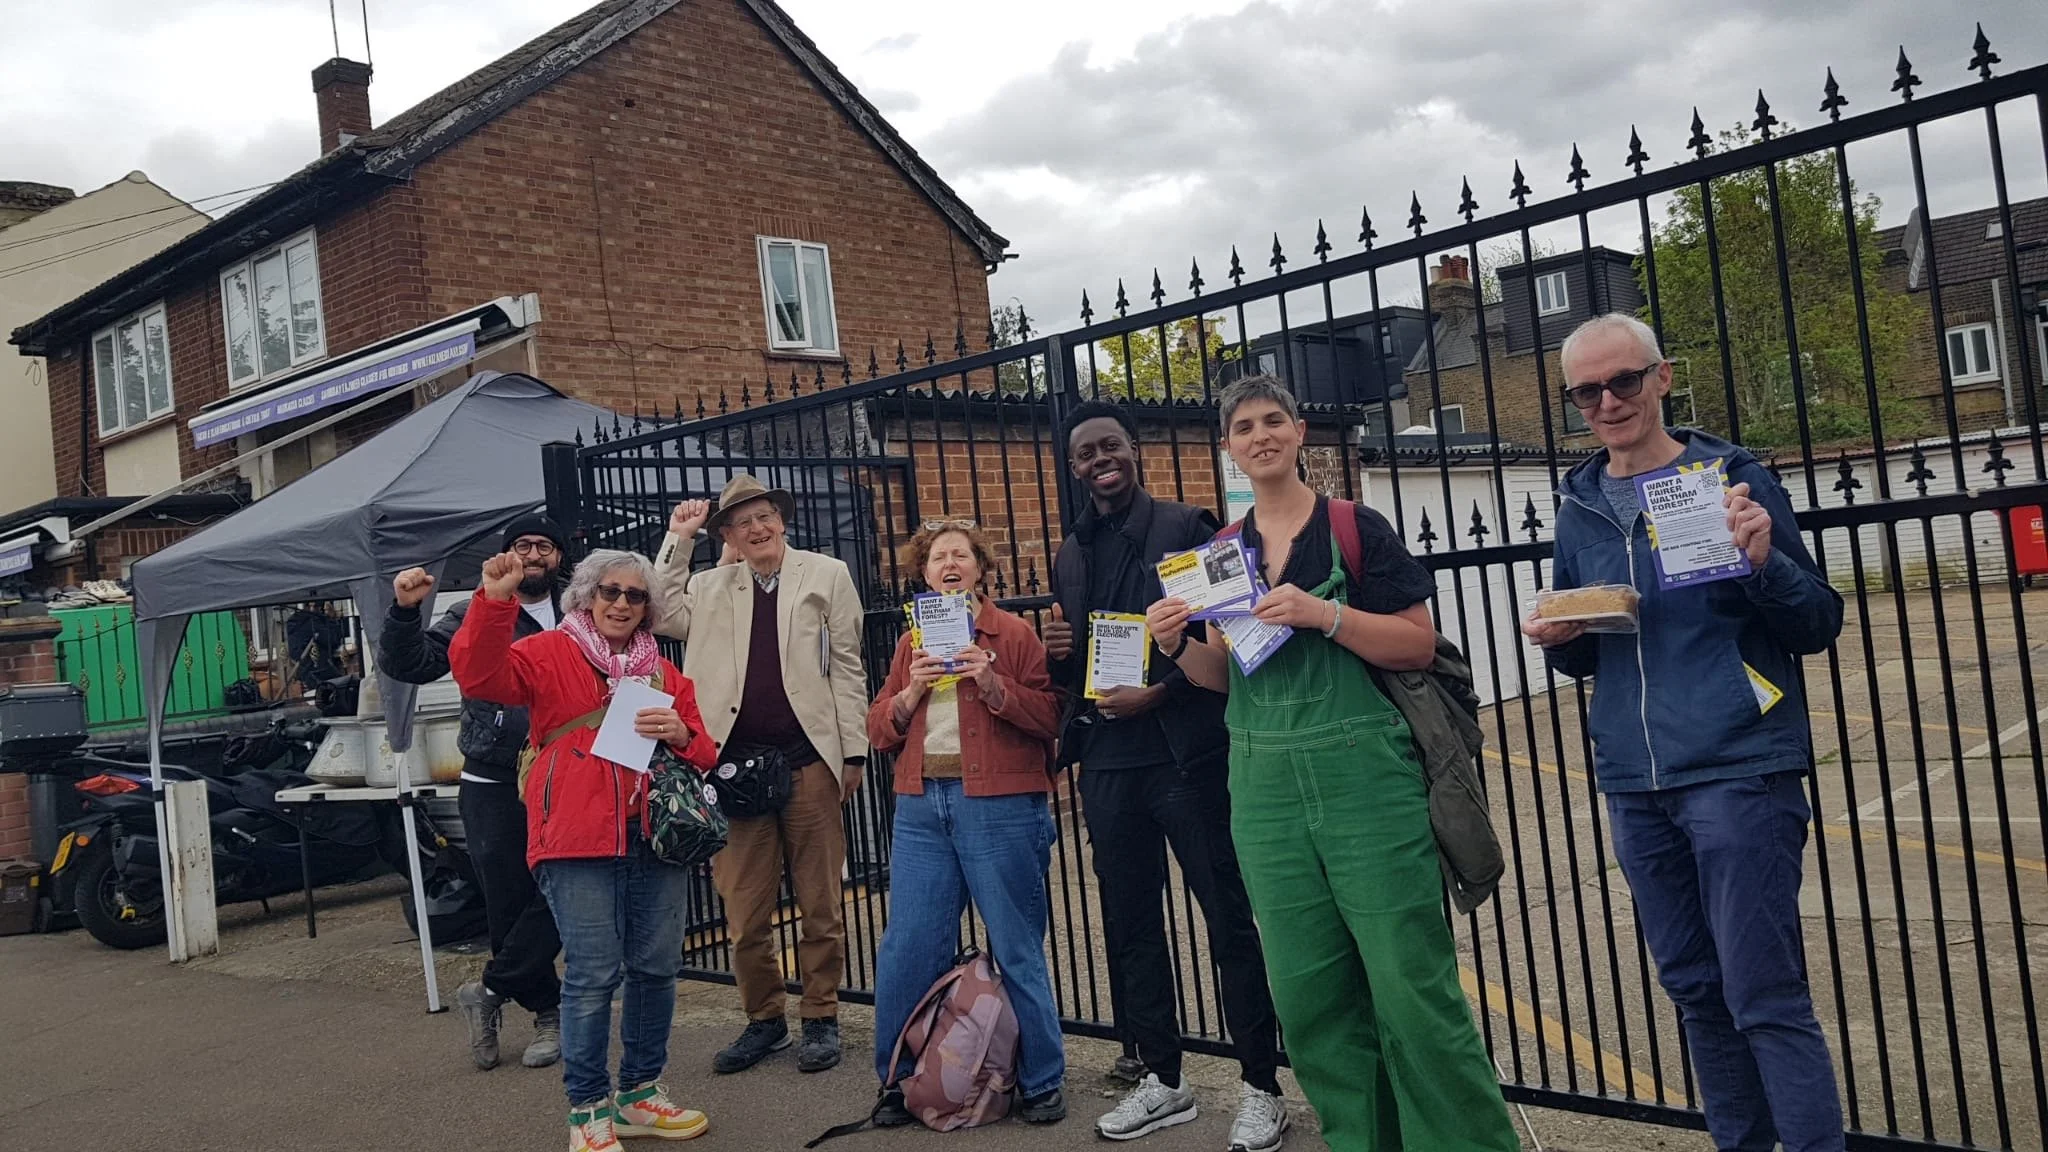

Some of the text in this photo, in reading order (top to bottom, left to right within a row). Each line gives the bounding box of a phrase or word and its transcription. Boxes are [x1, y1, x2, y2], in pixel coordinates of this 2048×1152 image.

[1646, 479, 1674, 491] WANT
[1648, 485, 1683, 498] FAIRER
[1650, 490, 1698, 505] WALTHAM
[1652, 498, 1695, 512] FOREST?
